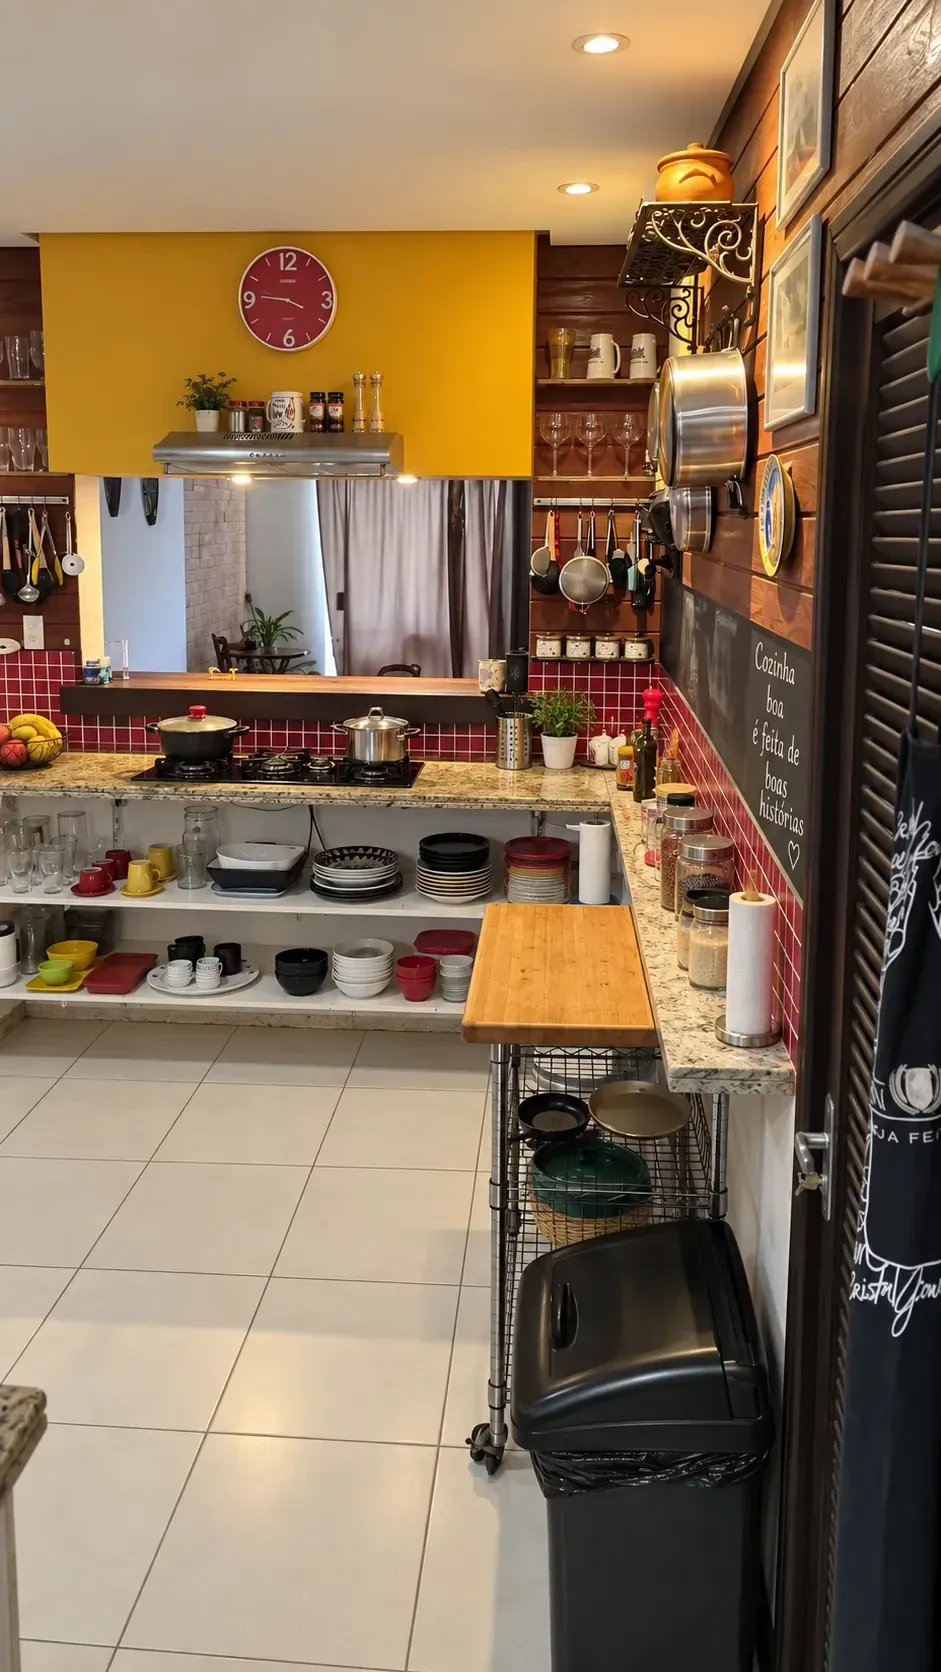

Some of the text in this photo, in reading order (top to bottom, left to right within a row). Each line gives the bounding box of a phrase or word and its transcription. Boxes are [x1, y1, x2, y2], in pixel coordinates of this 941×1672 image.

[279, 252, 297, 271] 12
[243, 291, 256, 309] 9
[321, 291, 333, 309] 3
[283, 329, 295, 347] 6
[755, 641, 795, 685] Cozinha
[766, 684, 784, 719] boa
[752, 719, 800, 766] é feita de
[765, 760, 788, 798] boas
[759, 789, 804, 837] histórias
